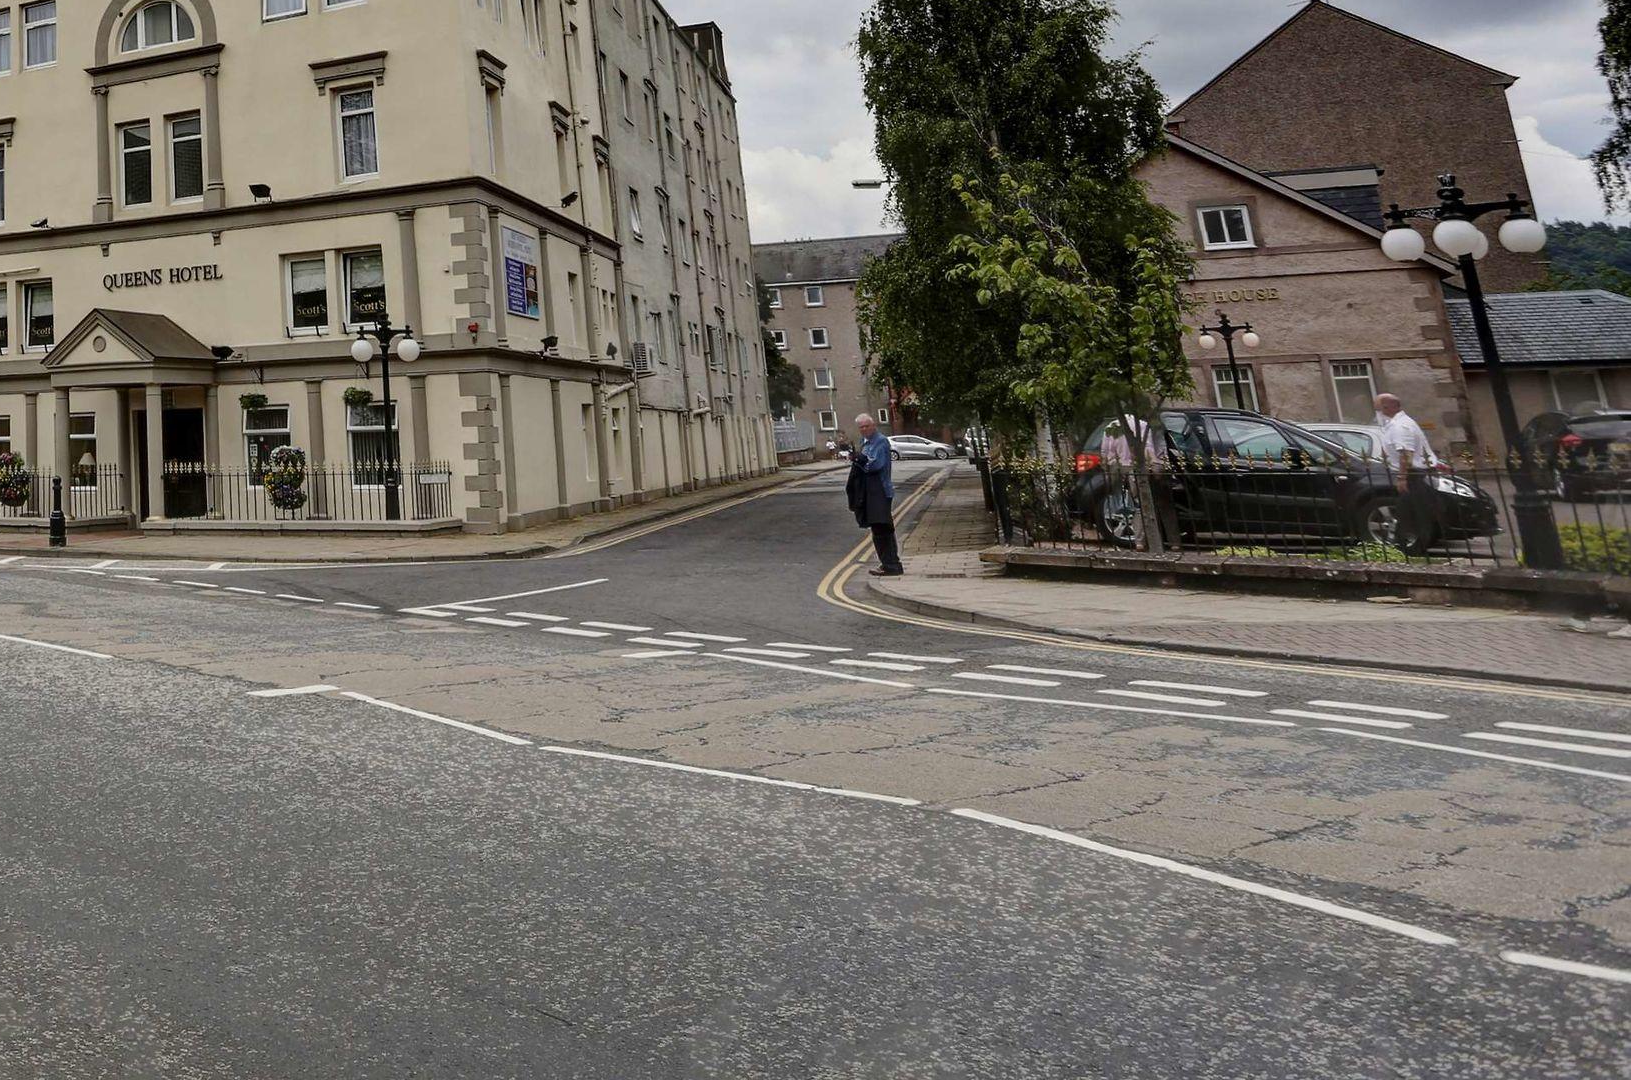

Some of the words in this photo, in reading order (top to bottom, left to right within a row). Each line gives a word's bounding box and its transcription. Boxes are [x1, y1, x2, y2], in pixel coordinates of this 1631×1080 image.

[103, 268, 162, 292] QUEENS
[169, 264, 223, 283] HOTEL
[1213, 287, 1281, 304] HOUSE
[297, 304, 326, 315] Scott's
[356, 299, 385, 312] Scott's
